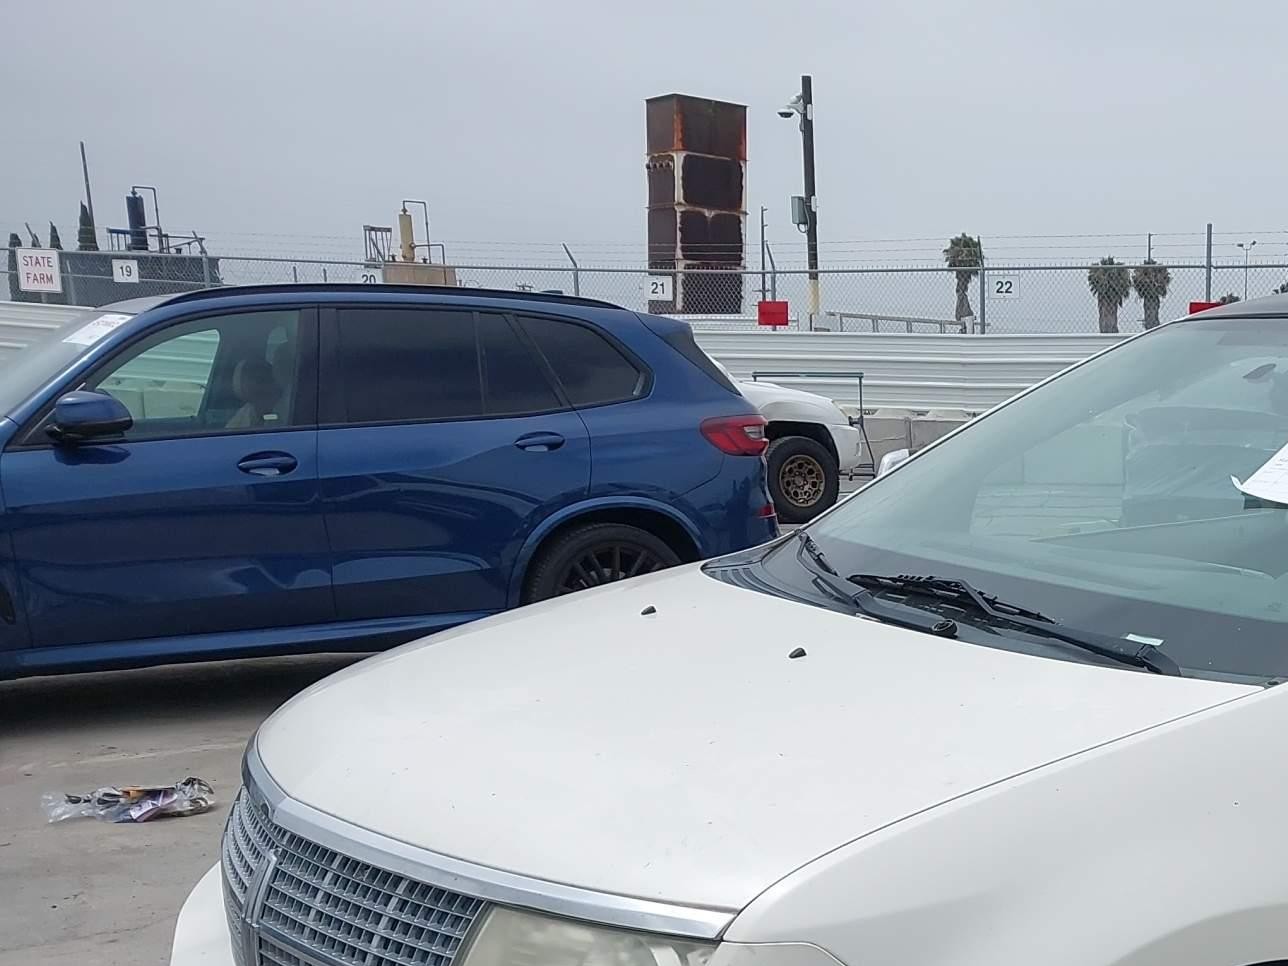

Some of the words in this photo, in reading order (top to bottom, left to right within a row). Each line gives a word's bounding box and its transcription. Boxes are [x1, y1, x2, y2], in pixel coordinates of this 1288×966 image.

[22, 255, 54, 268] STATE
[119, 264, 132, 278] 19
[25, 272, 54, 285] FARM
[361, 273, 377, 284] 20
[650, 281, 665, 295] 21
[995, 280, 1013, 294] 22
